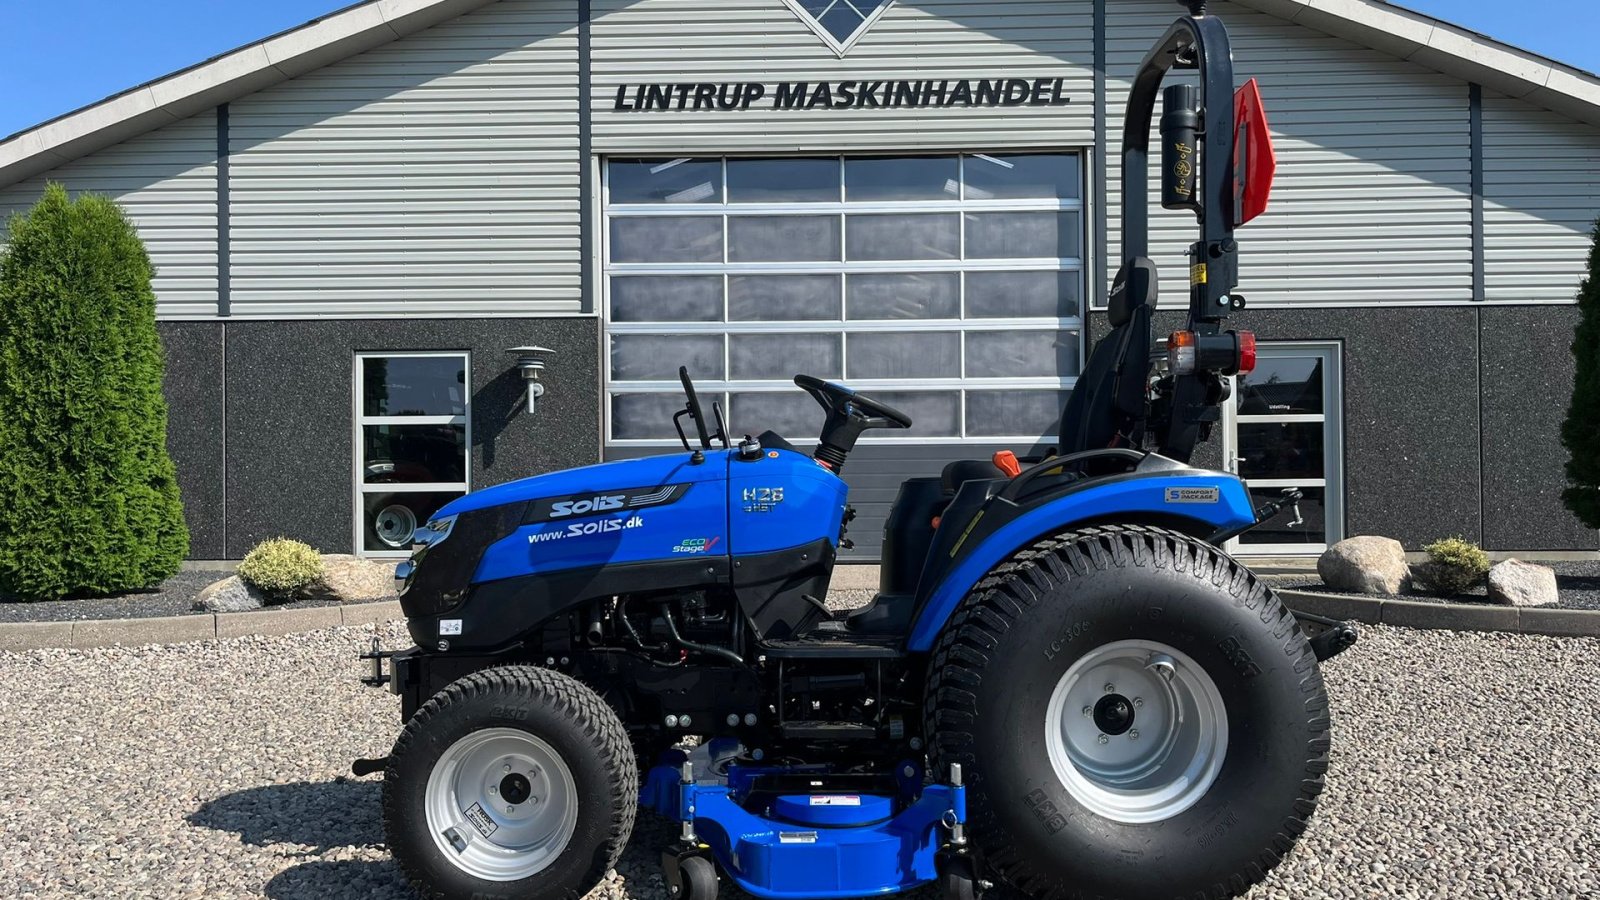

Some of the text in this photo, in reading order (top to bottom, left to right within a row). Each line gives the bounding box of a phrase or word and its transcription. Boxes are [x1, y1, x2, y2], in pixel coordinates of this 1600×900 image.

[613, 77, 1071, 111] LINTRUP MASKINHANDEL
[682, 538, 706, 546] ECO
[671, 545, 705, 554] Stage
